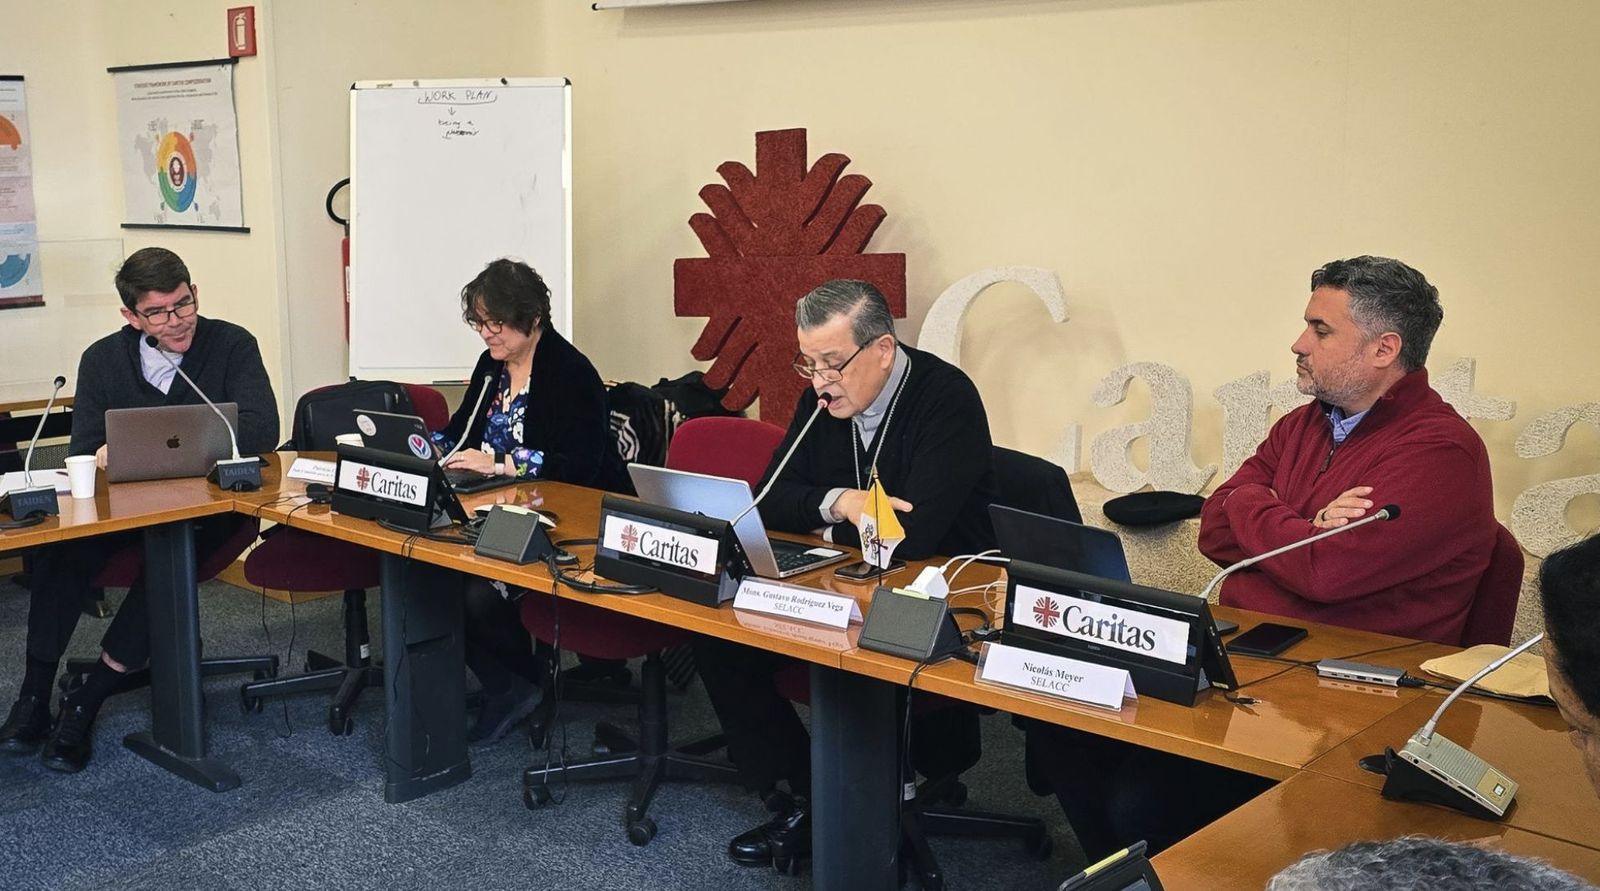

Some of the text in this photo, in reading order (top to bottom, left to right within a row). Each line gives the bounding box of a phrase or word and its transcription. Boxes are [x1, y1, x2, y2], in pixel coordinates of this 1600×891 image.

[424, 89, 493, 103] WORK PLAN
[371, 471, 417, 501] Caritas
[639, 530, 699, 568] Caritas
[763, 591, 790, 602] Gustavo
[828, 601, 844, 612] Vega
[774, 603, 804, 614] SELACC
[1063, 605, 1156, 651] Caritas
[1022, 662, 1085, 683] Nicolás Meyer
[1030, 675, 1070, 692] SELACC
